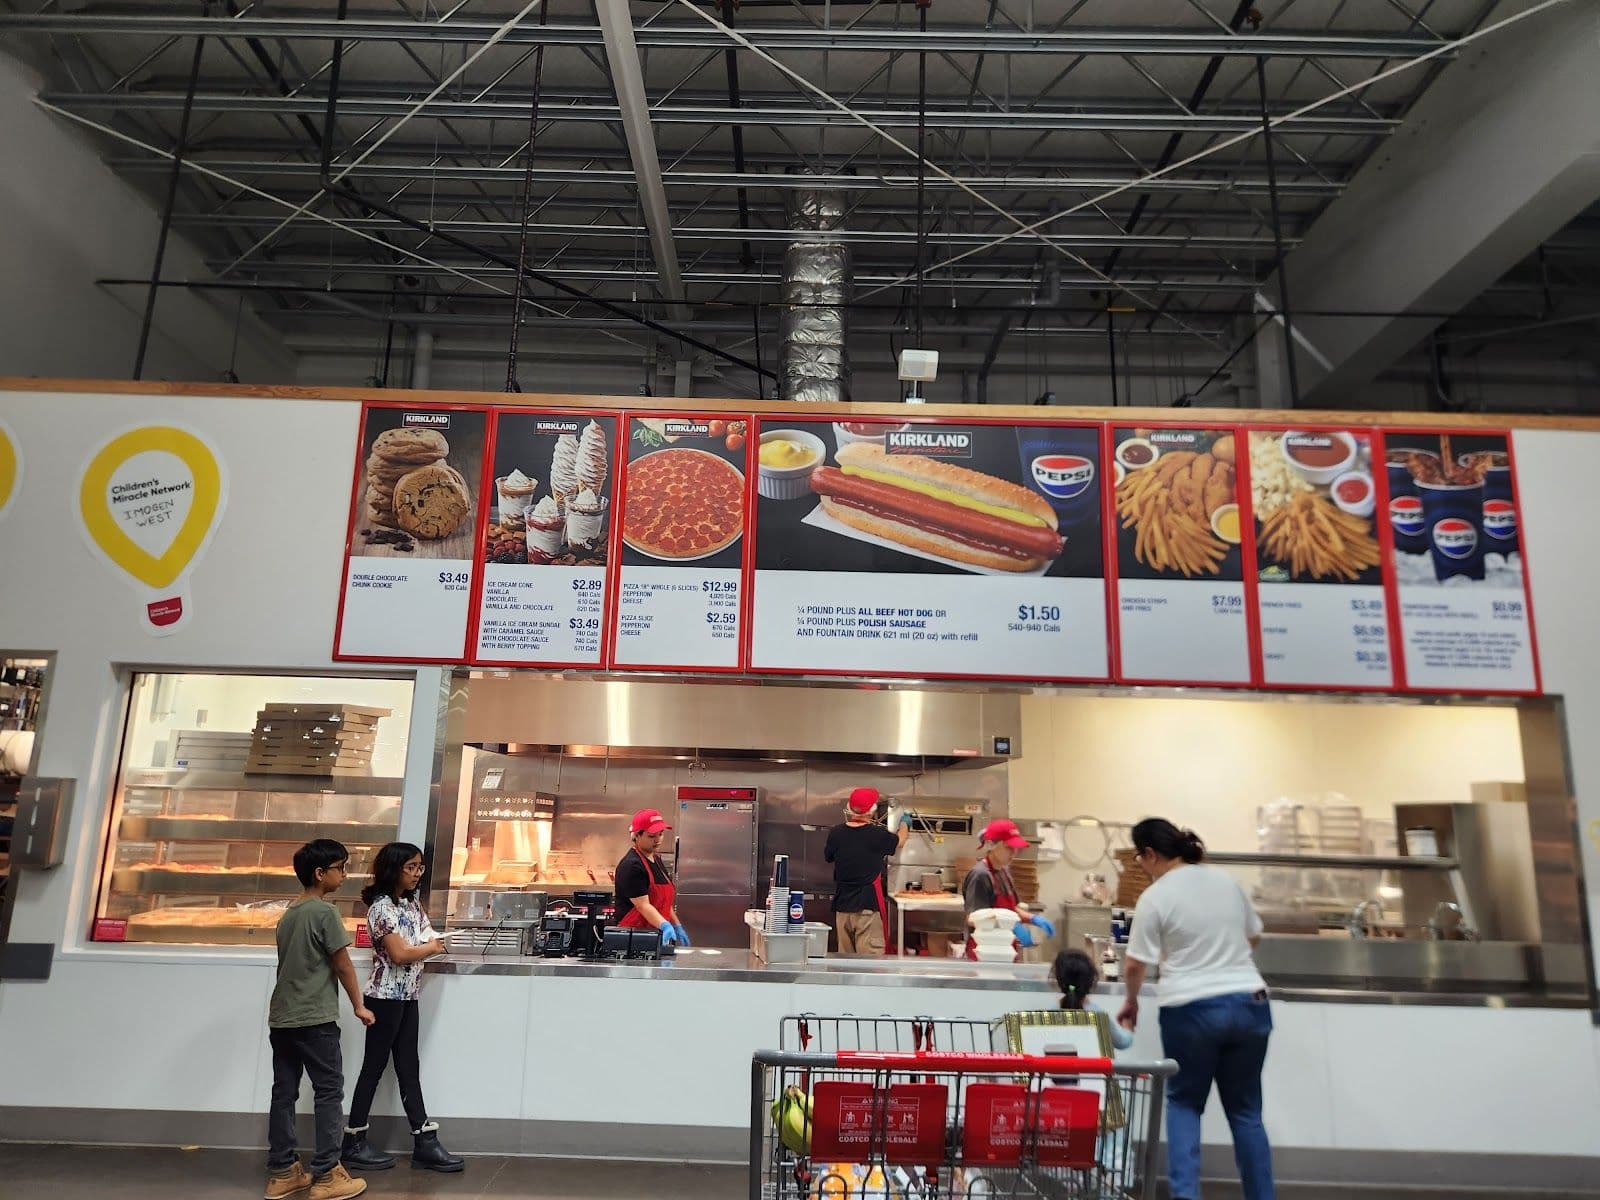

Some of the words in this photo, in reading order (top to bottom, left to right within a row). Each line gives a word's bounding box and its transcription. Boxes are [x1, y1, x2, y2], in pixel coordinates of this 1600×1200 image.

[406, 414, 448, 423] KIRKLAND
[536, 422, 577, 430] KIRKLAND
[666, 424, 708, 432] KIRKLAND
[889, 433, 969, 447] KIRKLAND
[1036, 467, 1090, 482] PEPSI
[112, 478, 160, 494] Children's
[112, 491, 148, 504] Miracle
[150, 480, 191, 496] Network
[124, 499, 174, 520] IMOGEN
[136, 511, 172, 527] WEST
[438, 572, 468, 584] $3.49
[572, 580, 602, 590] $2.89
[702, 581, 737, 592] $12.99
[1212, 595, 1242, 606] $7.99
[706, 612, 736, 624] $2.59
[807, 606, 834, 614] POUND
[836, 606, 856, 615] PLUS
[858, 607, 872, 616] ALL
[876, 608, 895, 616] BEEF
[898, 608, 914, 616] HOT
[916, 609, 933, 617] DOG
[935, 610, 947, 618] OR
[1018, 604, 1060, 621] $1.50
[570, 618, 598, 630] $3.49
[807, 617, 834, 626] POUND
[836, 618, 856, 626] PLUS
[858, 618, 887, 627] POLISH
[889, 620, 926, 628] SAUSAGE
[1044, 624, 1061, 632] Cals
[797, 628, 814, 636] AND
[816, 628, 854, 638] FOUNTAIN
[856, 630, 880, 638] DRINK
[883, 630, 897, 639] 621
[900, 631, 910, 640] ml
[912, 631, 926, 641] (20
[926, 632, 938, 642] oz)
[941, 632, 958, 641] with
[960, 632, 978, 642] refill
[990, 1138, 1020, 1146] COSTCO
